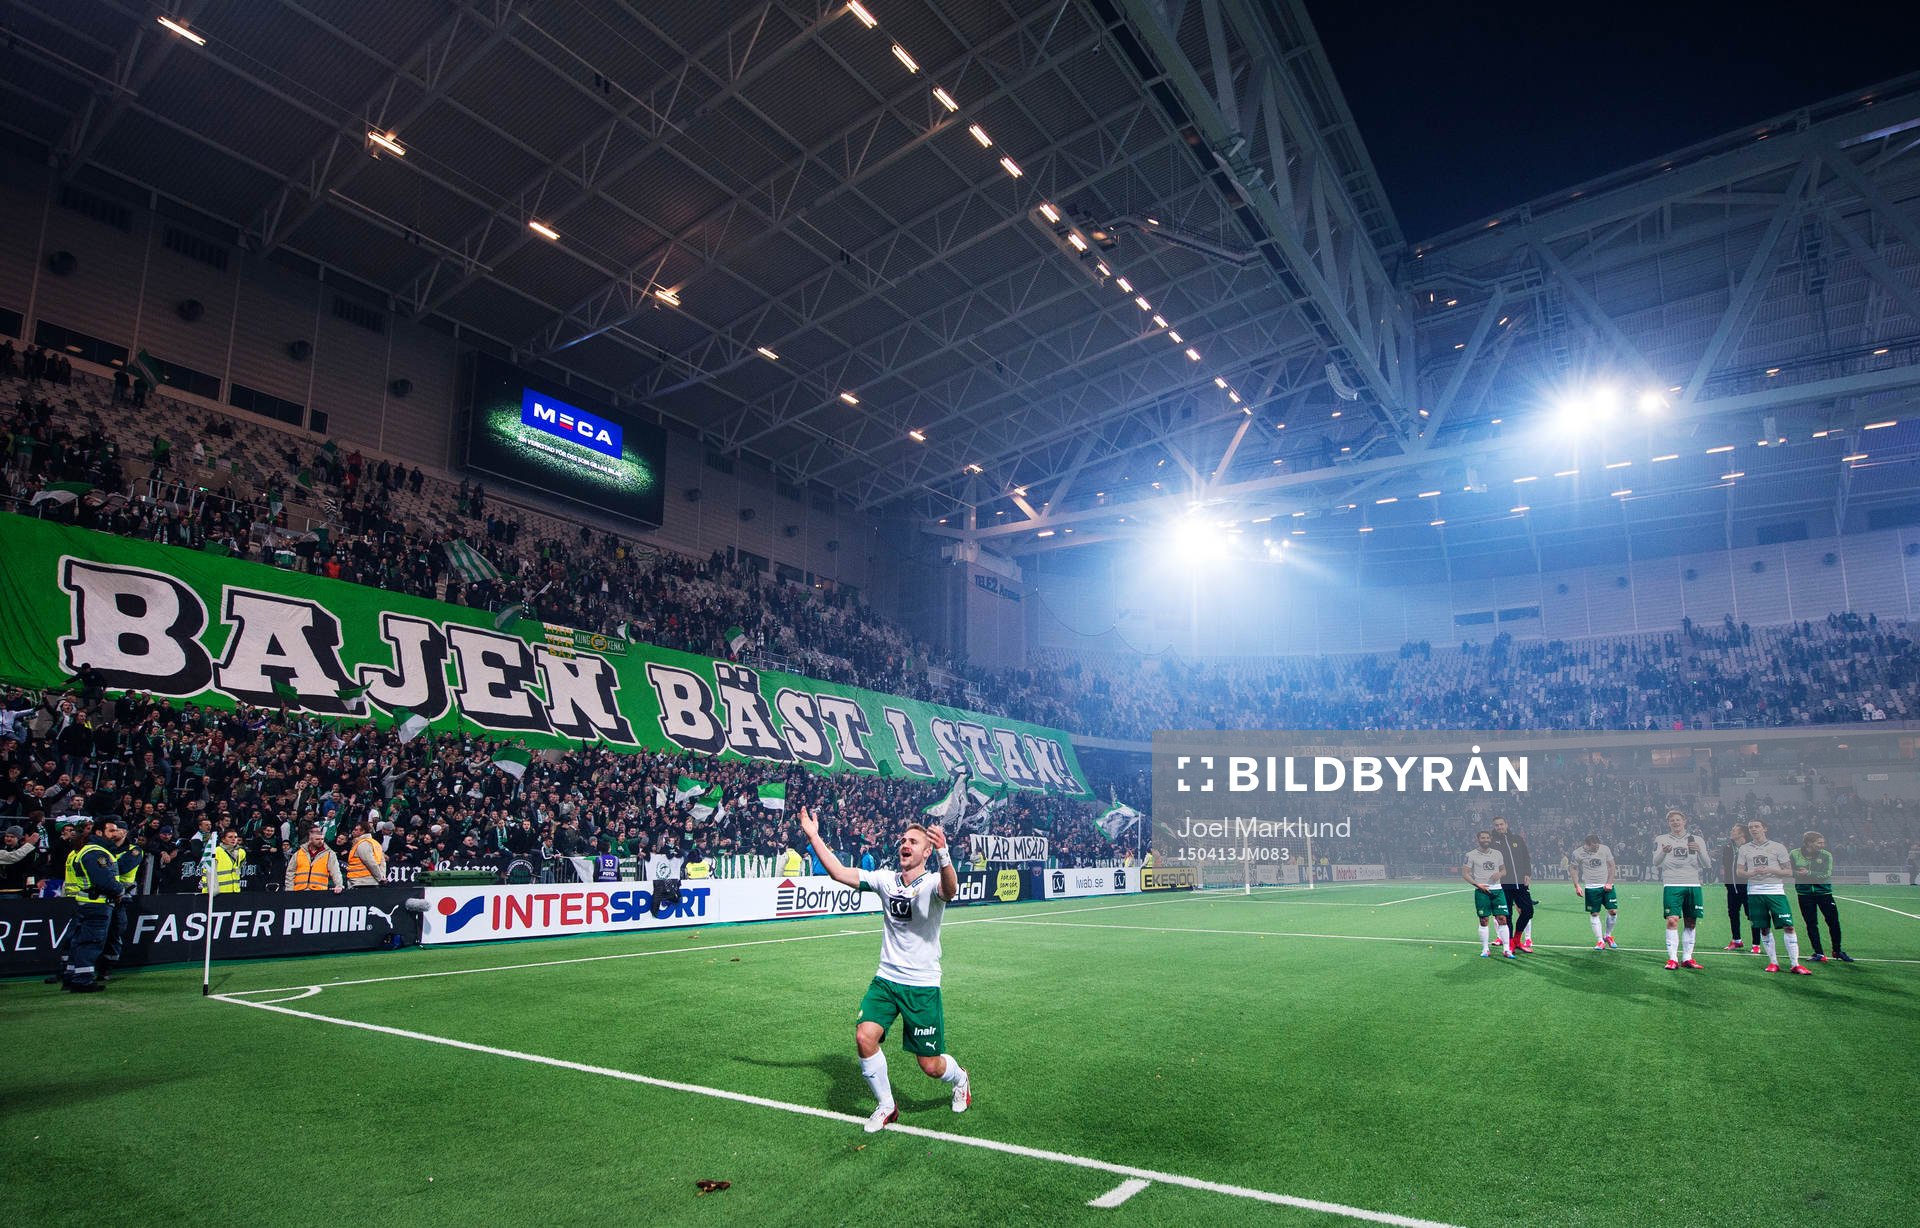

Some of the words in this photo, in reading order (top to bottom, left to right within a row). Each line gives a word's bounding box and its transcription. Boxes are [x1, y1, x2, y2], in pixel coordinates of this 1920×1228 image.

[533, 402, 613, 446] MECA
[57, 555, 641, 746] BAJEN
[645, 661, 878, 771] BÄST
[883, 706, 935, 777] I
[604, 859, 614, 868] 33
[991, 836, 1010, 860] ÄR
[1014, 836, 1045, 860] MISÄR
[796, 886, 862, 912] Botrygg
[132, 909, 276, 944] FASTER
[283, 906, 368, 936] PUMA
